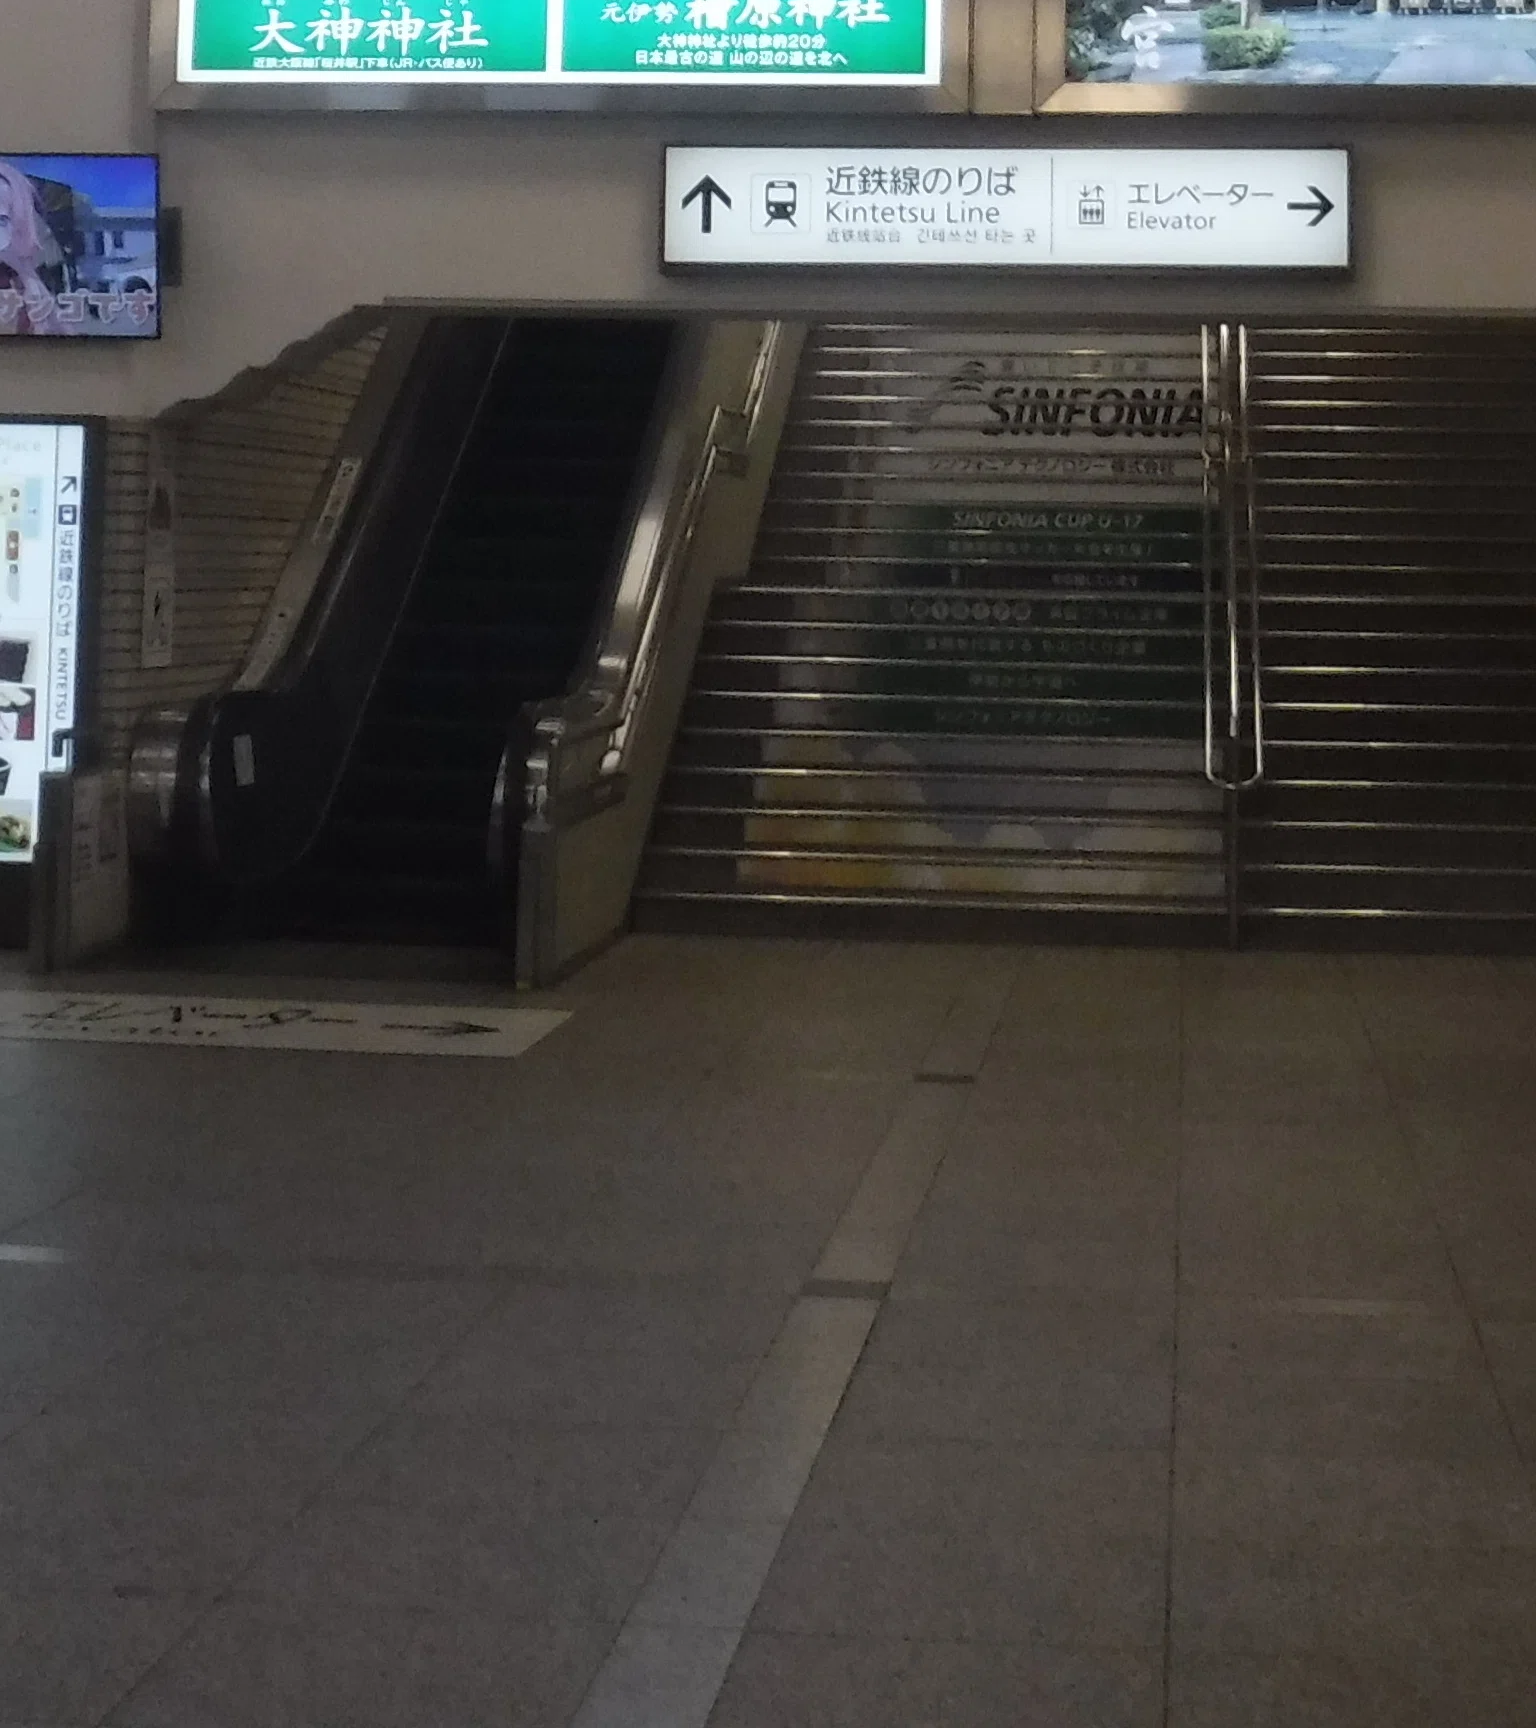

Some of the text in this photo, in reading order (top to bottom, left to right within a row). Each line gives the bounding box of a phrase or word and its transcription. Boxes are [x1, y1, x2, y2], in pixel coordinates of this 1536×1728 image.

[249, 7, 490, 57] 大神神社
[826, 165, 1019, 197] 近鉄線のりば
[1128, 183, 1274, 206] エレベーター
[826, 202, 1001, 224] Kintetsu Line
[1128, 210, 1216, 231] Elevator
[982, 387, 1205, 437] SINFONIA
